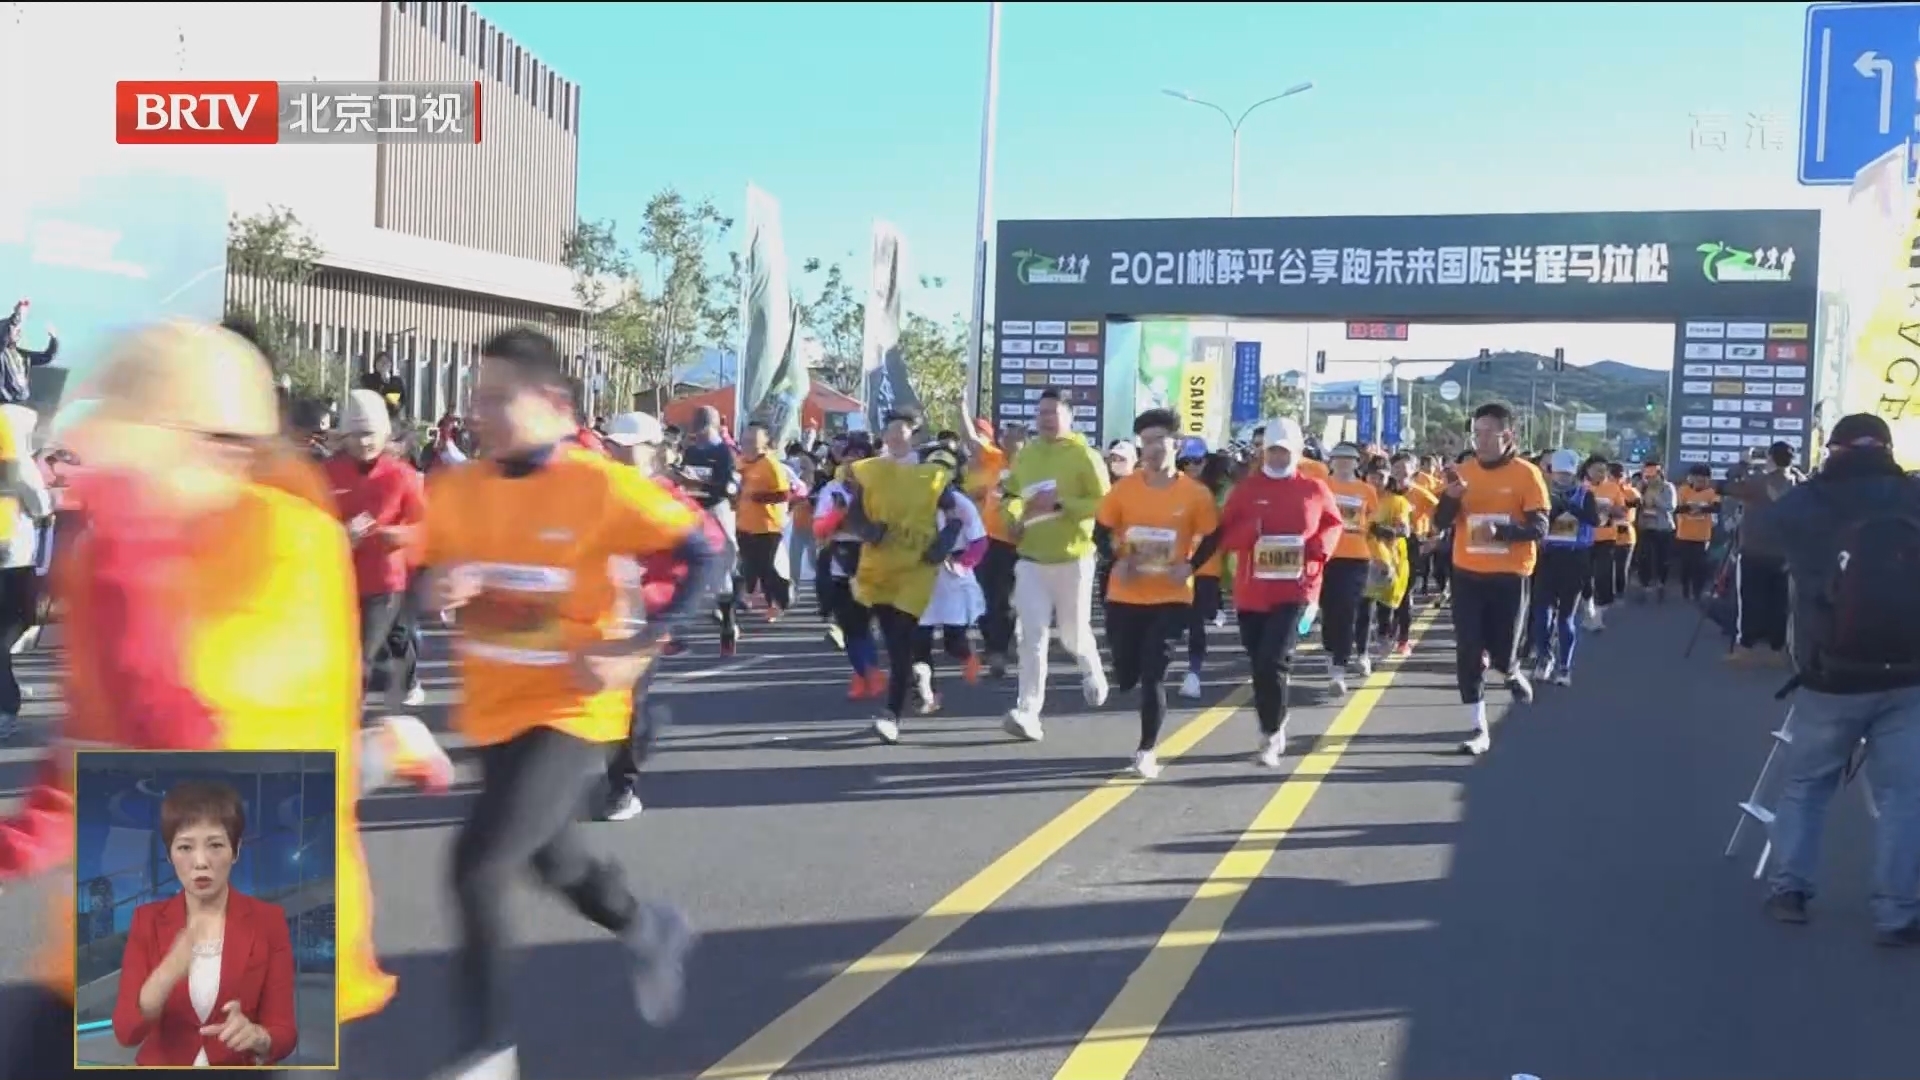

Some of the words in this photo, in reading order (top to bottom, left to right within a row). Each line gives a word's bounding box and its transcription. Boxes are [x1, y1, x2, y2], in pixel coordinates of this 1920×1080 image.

[1110, 243, 1669, 286] 2021桃醉平谷享跑未来国际半程马拉松
